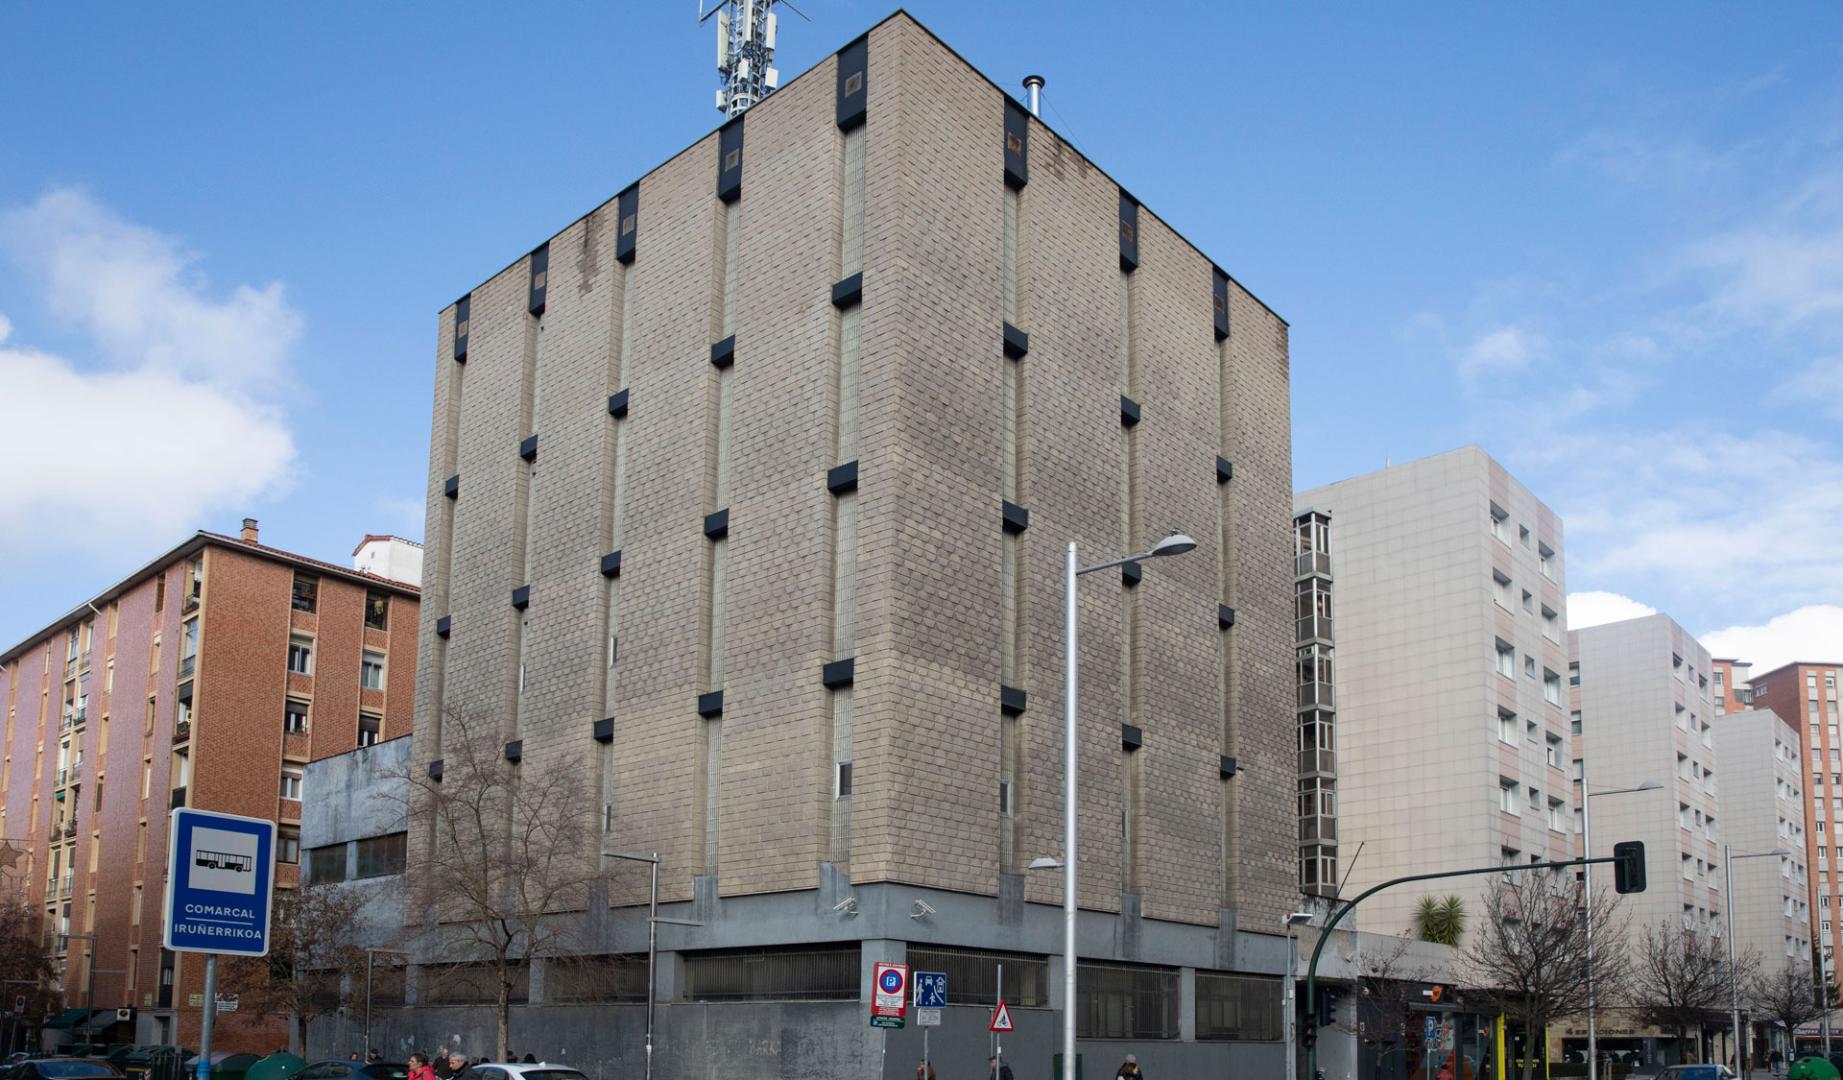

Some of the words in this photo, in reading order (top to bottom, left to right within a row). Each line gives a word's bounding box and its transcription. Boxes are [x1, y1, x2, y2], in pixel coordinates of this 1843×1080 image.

[185, 904, 255, 918] COMARCAL
[174, 923, 262, 939] IRUÑERRIKOA
[1428, 1019, 1434, 1036] P
